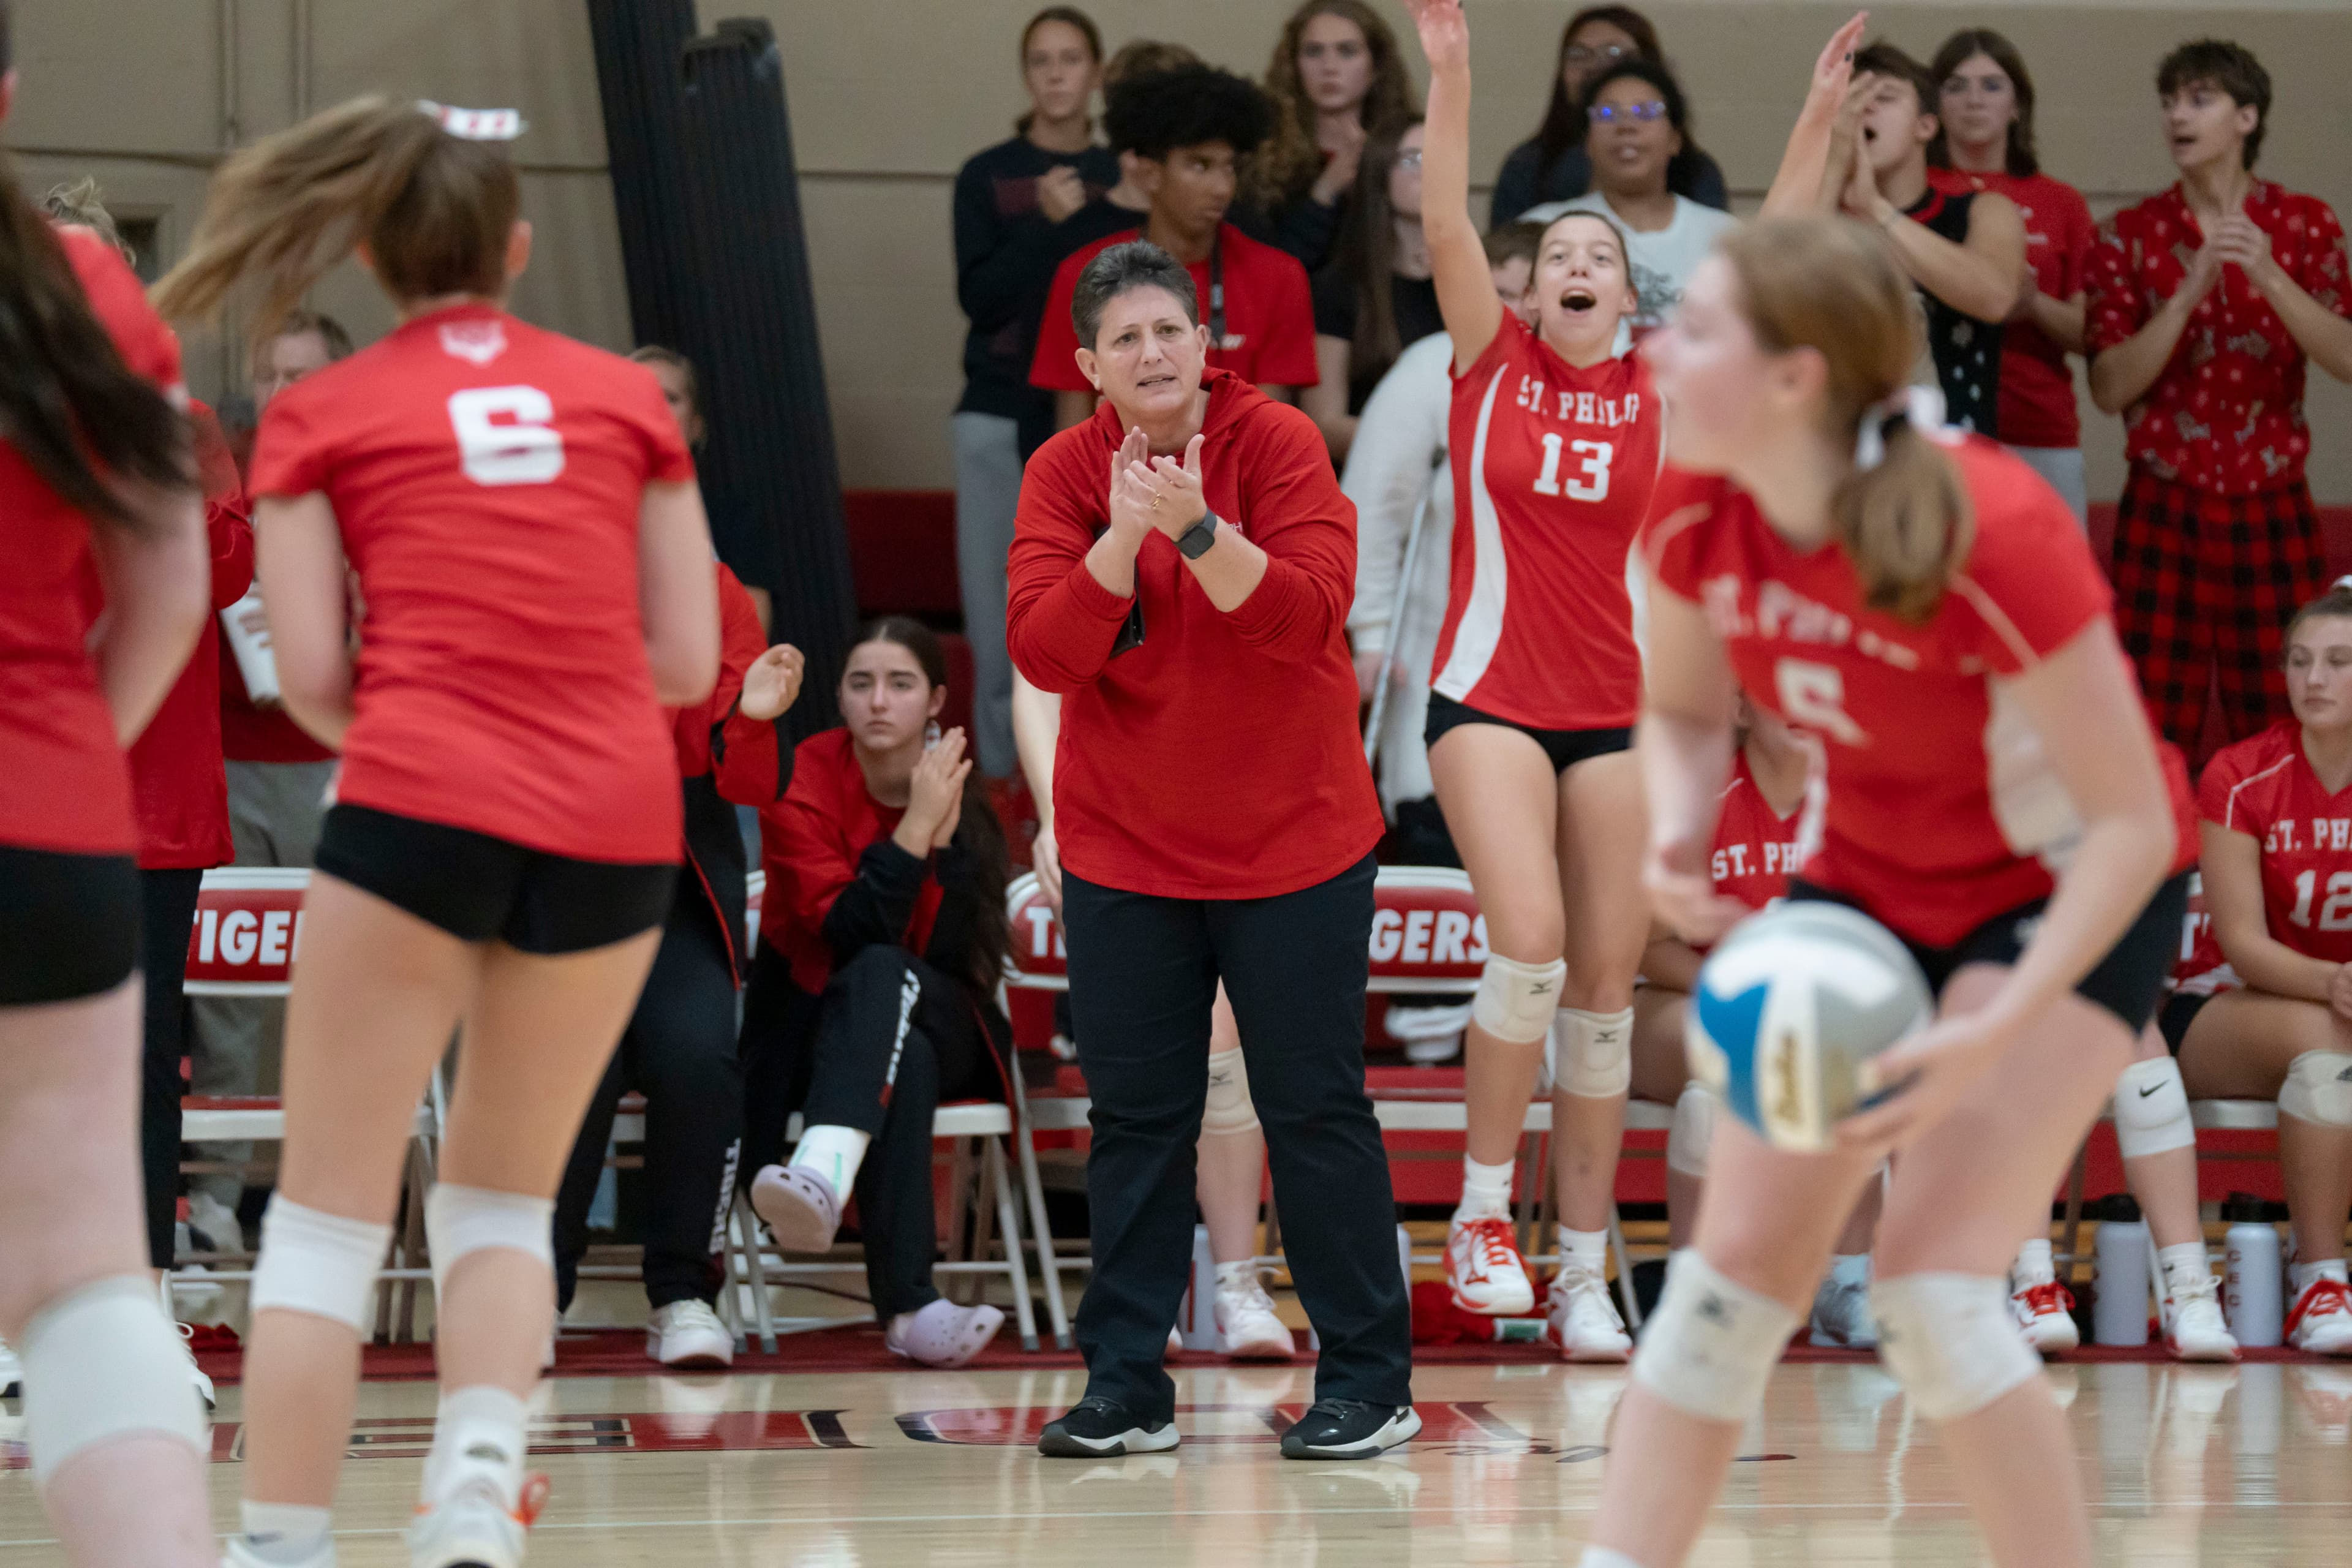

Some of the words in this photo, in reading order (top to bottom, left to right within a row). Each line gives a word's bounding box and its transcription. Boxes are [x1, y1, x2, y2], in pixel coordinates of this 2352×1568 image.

[447, 385, 567, 488] 6
[1532, 432, 1613, 502] 13
[1711, 843, 1756, 880] ST.
[2264, 819, 2302, 853] ST.
[2312, 818, 2352, 851] PH
[2288, 869, 2352, 932] 12
[193, 909, 306, 966] IGE
